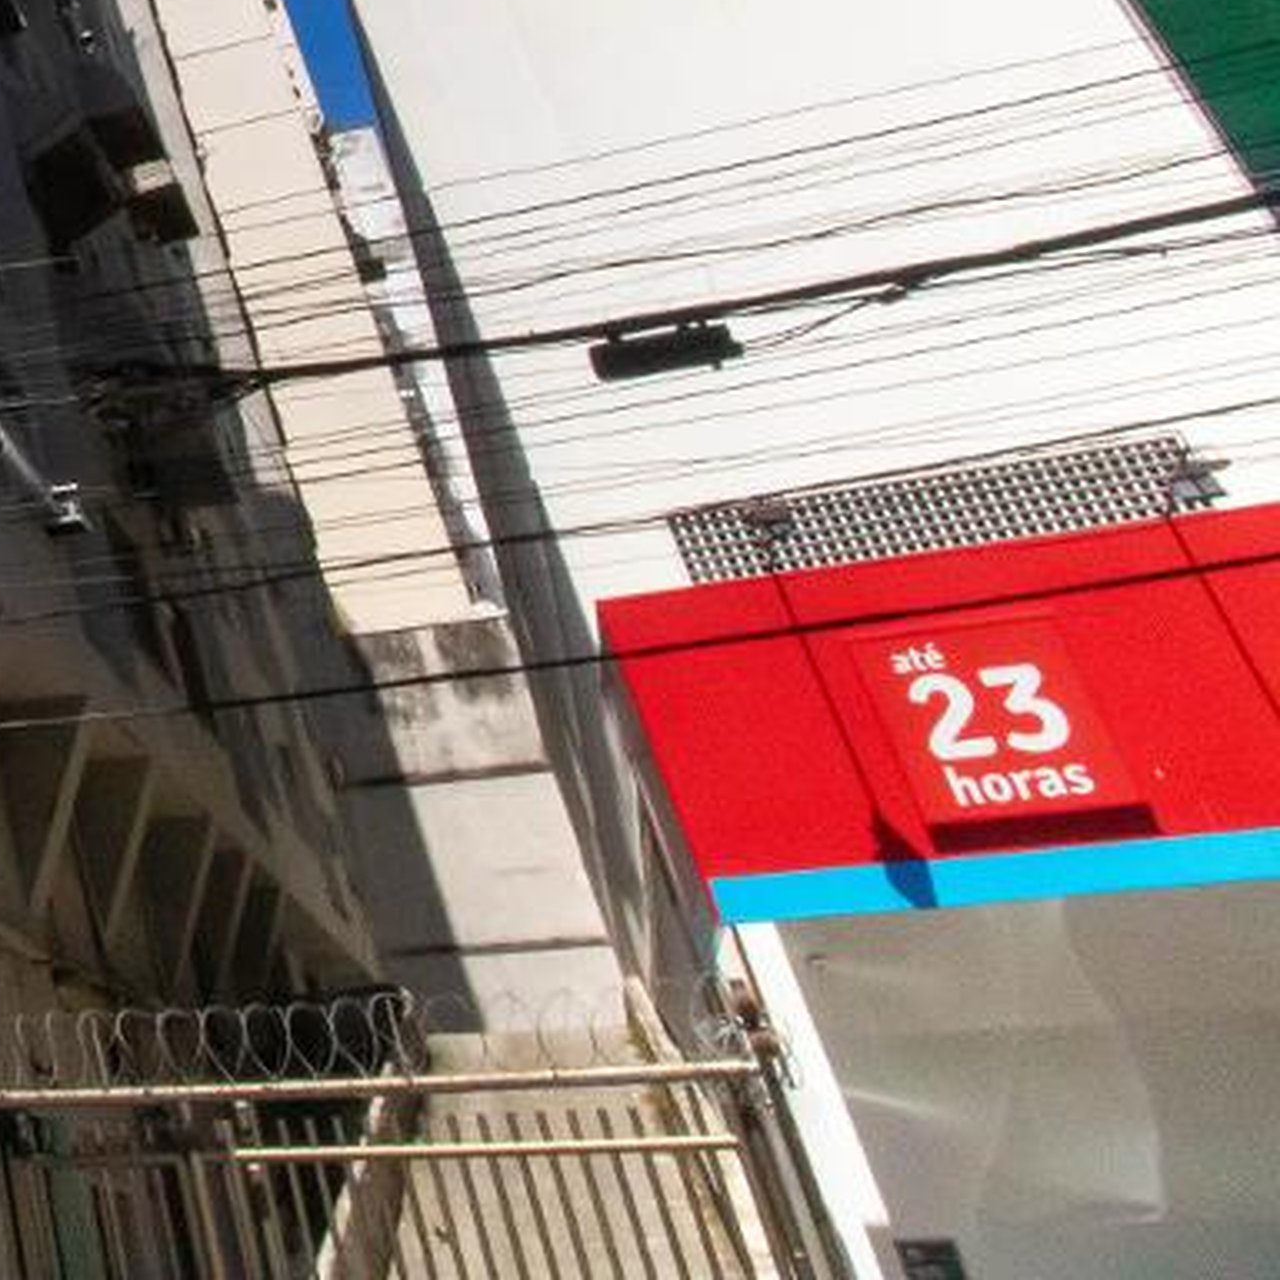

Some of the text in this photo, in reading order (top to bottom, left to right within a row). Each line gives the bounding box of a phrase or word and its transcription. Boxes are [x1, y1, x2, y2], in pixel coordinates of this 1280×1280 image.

[890, 642, 945, 673] até
[908, 663, 1071, 760] 23
[942, 764, 1095, 807] horas
